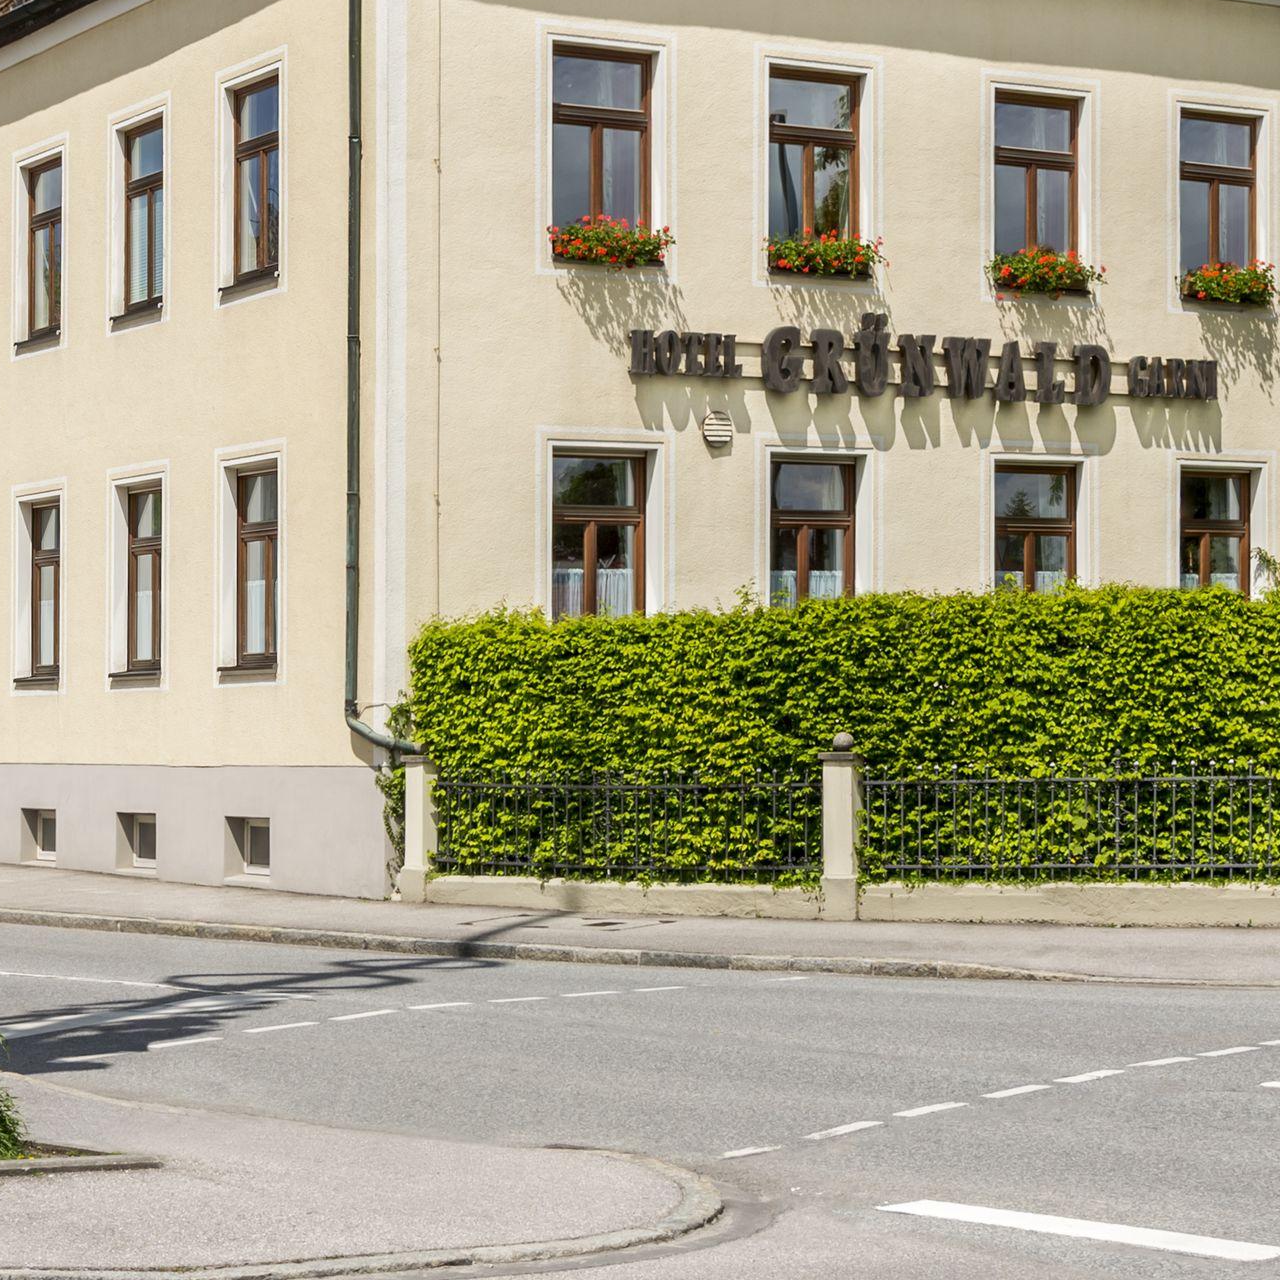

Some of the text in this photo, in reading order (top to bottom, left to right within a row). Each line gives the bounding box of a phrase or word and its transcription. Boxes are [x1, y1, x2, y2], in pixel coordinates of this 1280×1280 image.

[628, 312, 1218, 407] HOTEL GRÜNWALD GARNI
